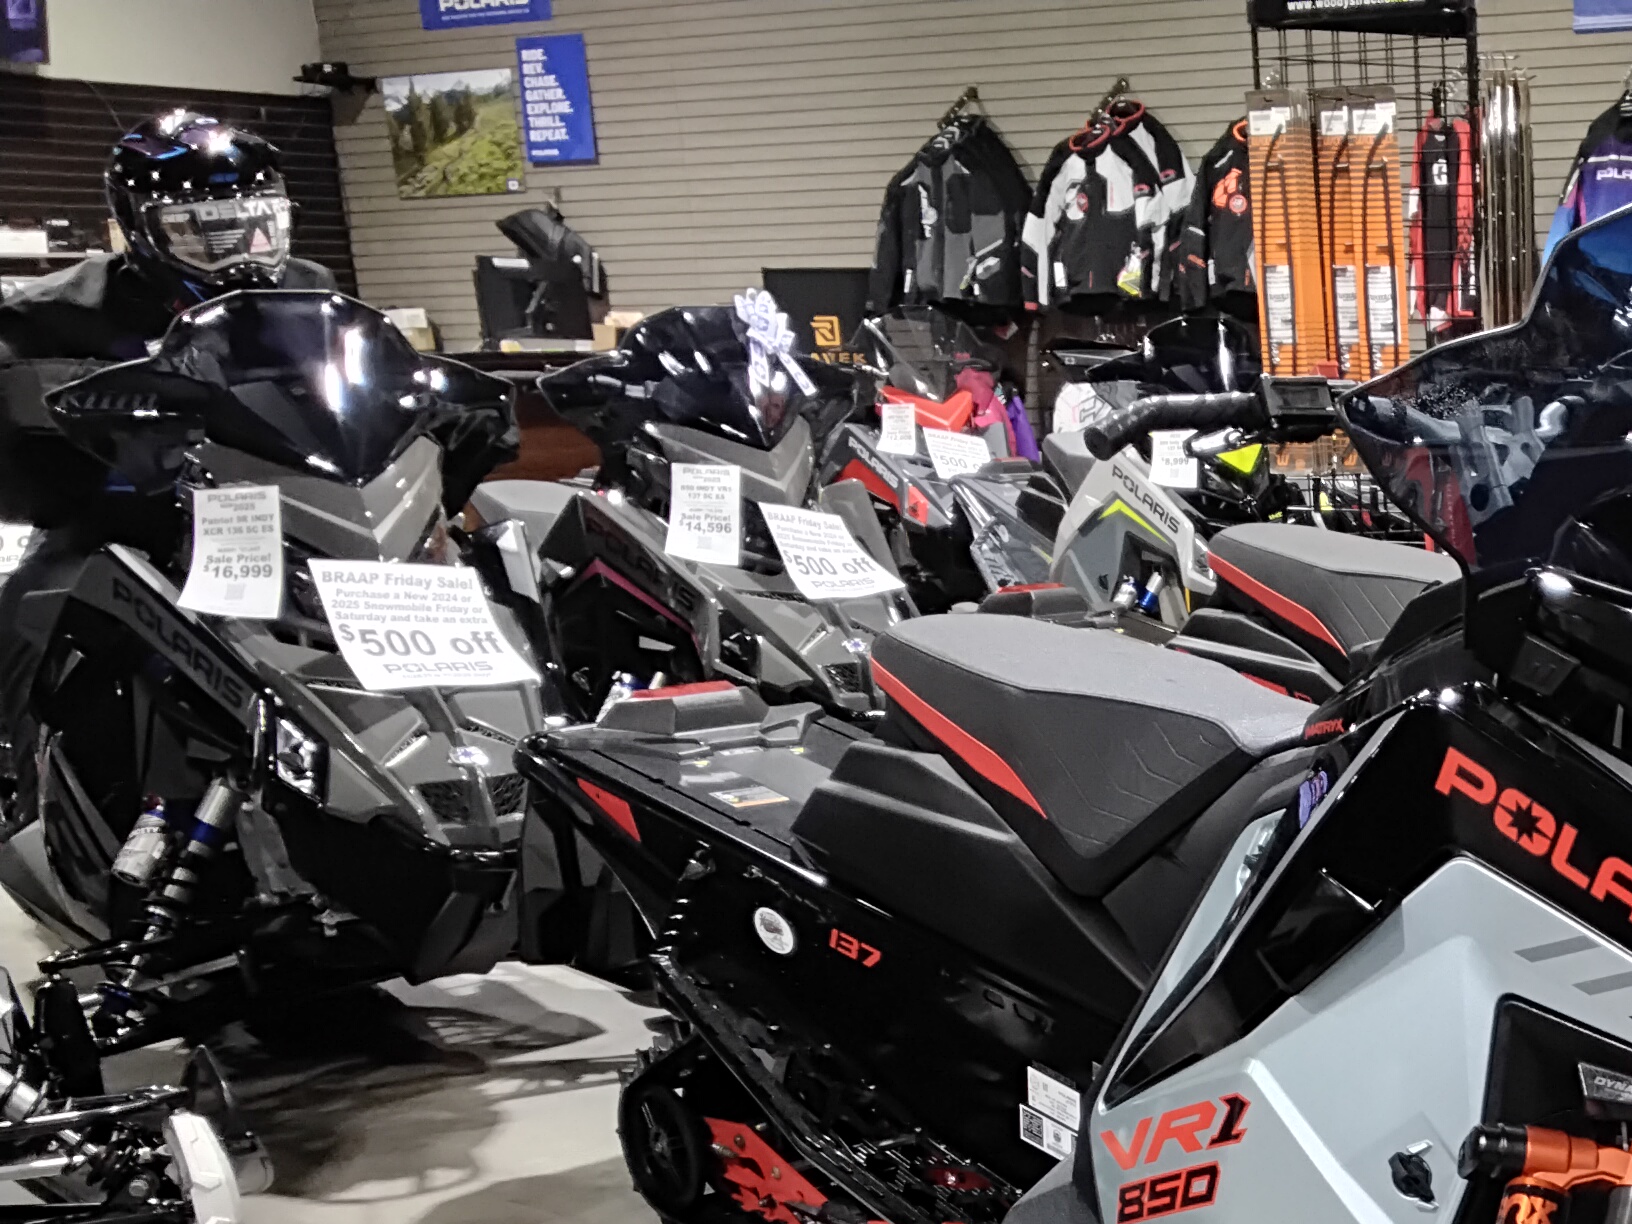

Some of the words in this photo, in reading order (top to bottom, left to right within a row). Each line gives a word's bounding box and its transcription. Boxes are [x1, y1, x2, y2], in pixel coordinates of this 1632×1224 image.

[1112, 464, 1181, 534] POLARIS
[206, 555, 233, 564] Sale
[237, 553, 271, 563] Price!
[842, 557, 876, 575] off
[203, 564, 273, 581] $16,999
[321, 571, 380, 584] BRAAP
[384, 572, 432, 590] Friday
[437, 576, 473, 590] Sale!
[335, 611, 387, 623] Saturday
[112, 577, 244, 710] POLARIS
[338, 623, 437, 657] $500
[449, 631, 505, 656] off
[382, 661, 494, 674] POLARIS
[829, 928, 882, 967] 137
[1100, 1092, 1252, 1171] VR1
